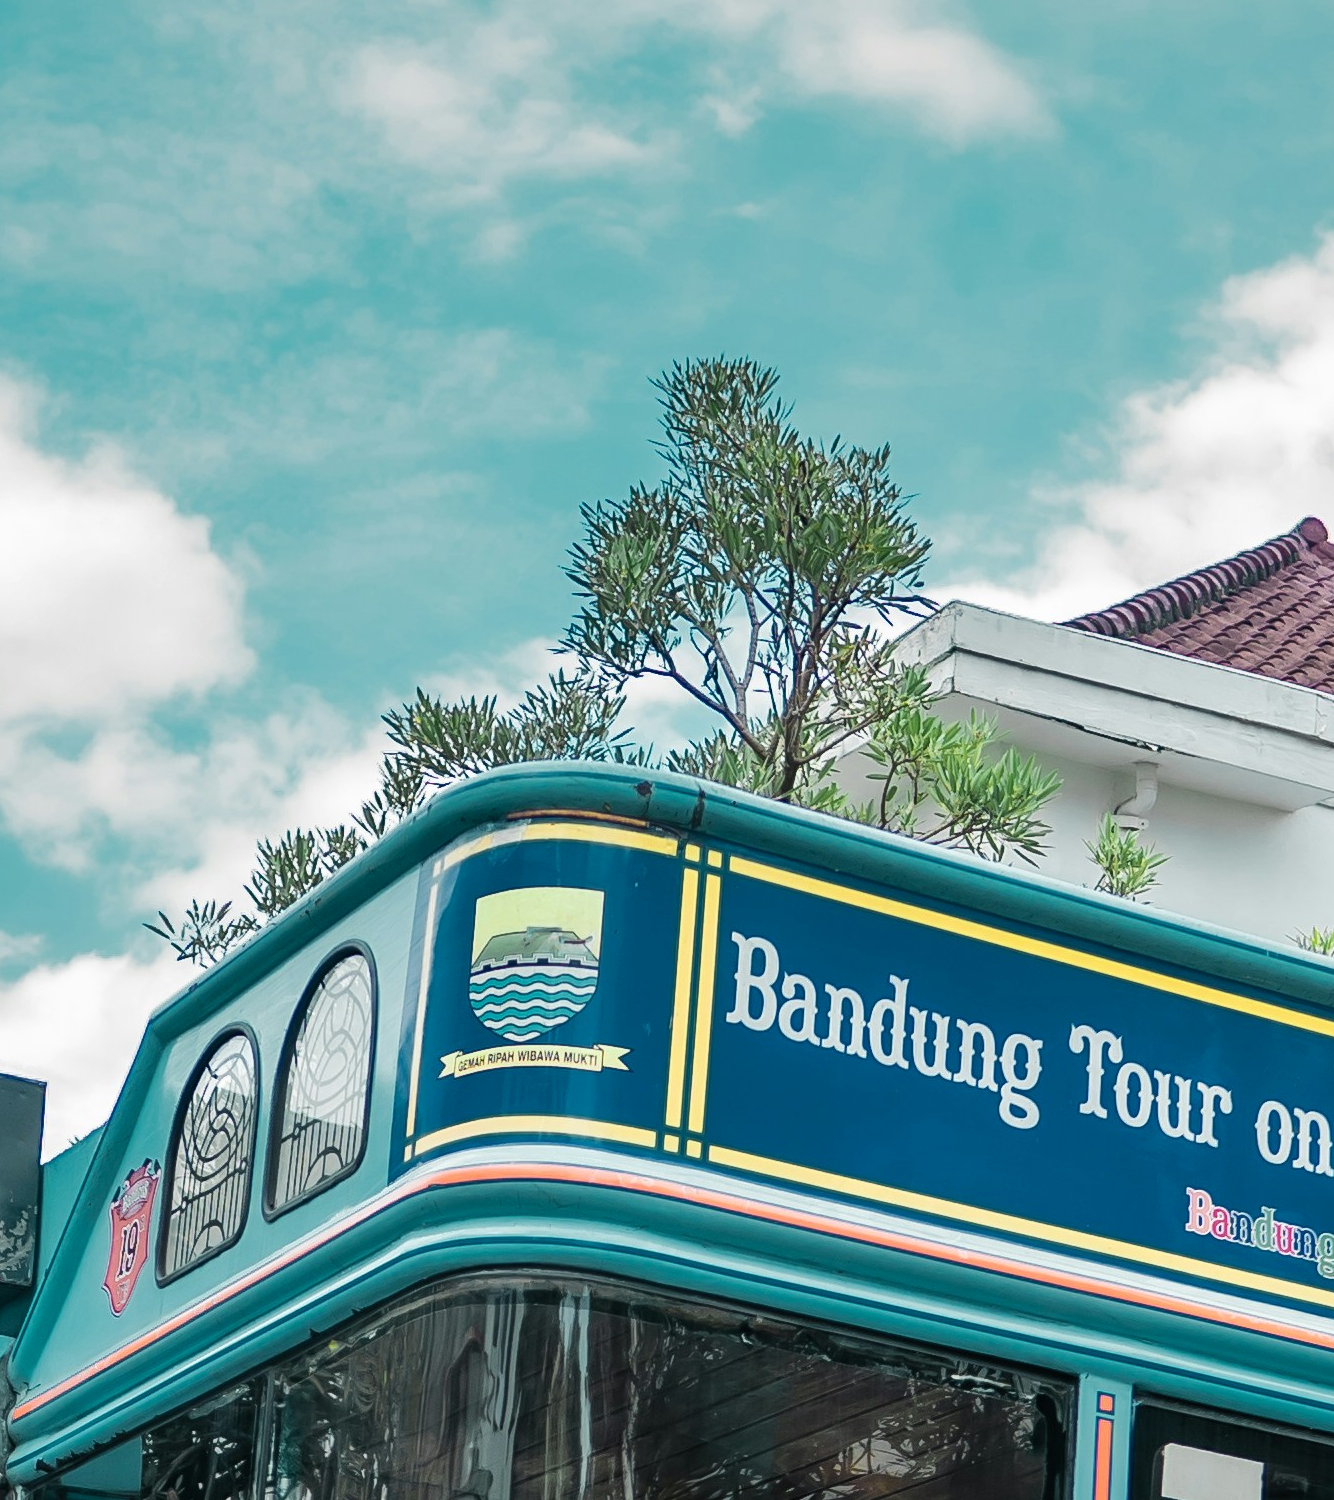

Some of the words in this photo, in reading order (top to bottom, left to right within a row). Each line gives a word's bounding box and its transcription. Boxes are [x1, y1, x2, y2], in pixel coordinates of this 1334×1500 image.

[457, 1055, 486, 1072] GEMAH
[487, 1051, 515, 1066] RIPAH
[517, 1049, 561, 1063] WIBAWA
[563, 1051, 598, 1067] MUKTI
[726, 931, 1044, 1130] Bandung
[1069, 1022, 1233, 1148] Tour
[1254, 1100, 1334, 1177] on
